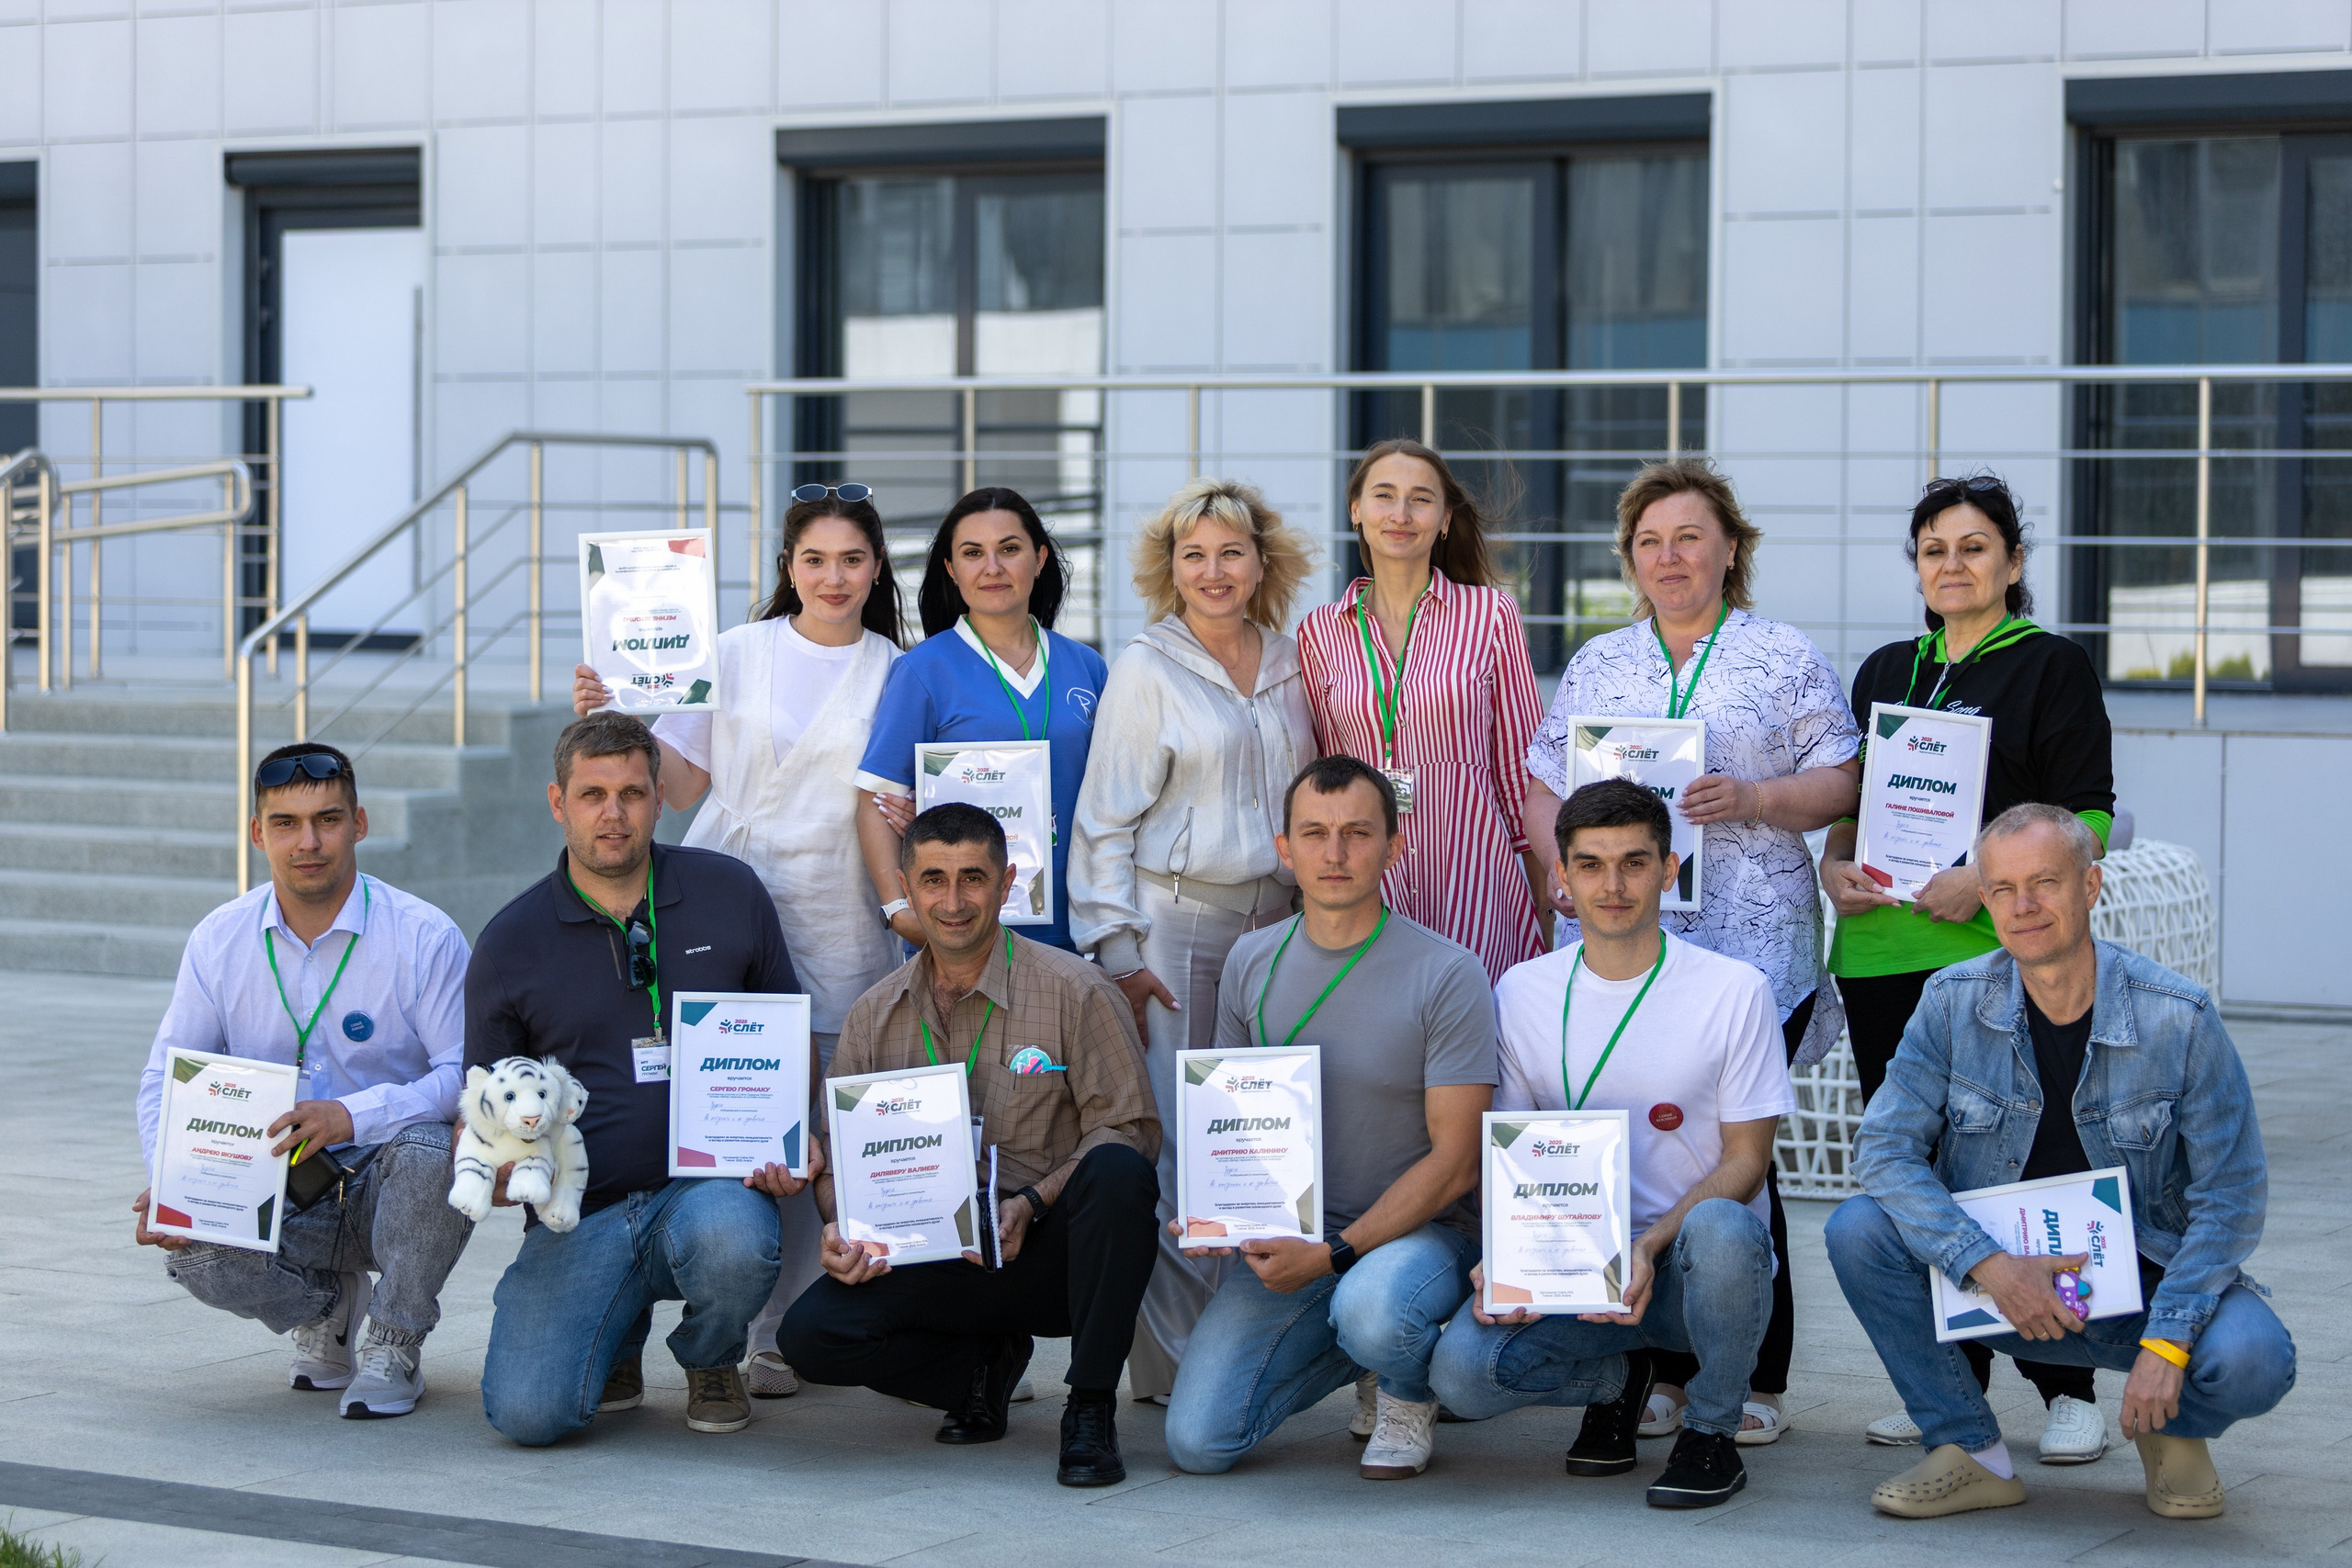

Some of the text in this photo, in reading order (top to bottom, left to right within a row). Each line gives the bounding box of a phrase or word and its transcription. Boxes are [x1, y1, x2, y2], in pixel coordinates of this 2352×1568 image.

[613, 634, 689, 652] ДИПЛОМ
[631, 676, 660, 687] СЛЁТ
[1627, 748, 1659, 759] СЛЁТ
[1919, 741, 1947, 753] СЛЁТ
[976, 771, 1005, 780] СЛЁТ
[1887, 774, 1957, 795] ДИПЛОМ
[733, 1022, 764, 1032] СЛЁТ
[641, 1063, 666, 1071] СЕРГЕЙ
[700, 1058, 780, 1071] ДИПЛОМ
[1240, 1079, 1273, 1089] СЛЁТ
[222, 1086, 252, 1099] СЛЁТ
[890, 1099, 922, 1112] СЛЁТ
[186, 1118, 263, 1140] ДИПЛОМ
[1207, 1117, 1291, 1134] ДИПЛОМ
[862, 1134, 942, 1157] ДИПЛОМ
[1547, 1143, 1580, 1154] СЛЁТ
[192, 1147, 253, 1161] АНДРЕЮ ЯКУШОВУ
[870, 1169, 907, 1178] ДИЛЯВЕРУ
[908, 1164, 940, 1173] ВАЛИЕВУ
[1513, 1182, 1599, 1199] ДИПЛОМ
[2019, 1208, 2029, 1244] ДМИТРИЮ
[2042, 1209, 2063, 1256] ДИПЛ
[2091, 1235, 2105, 1267] СЛЁТ
